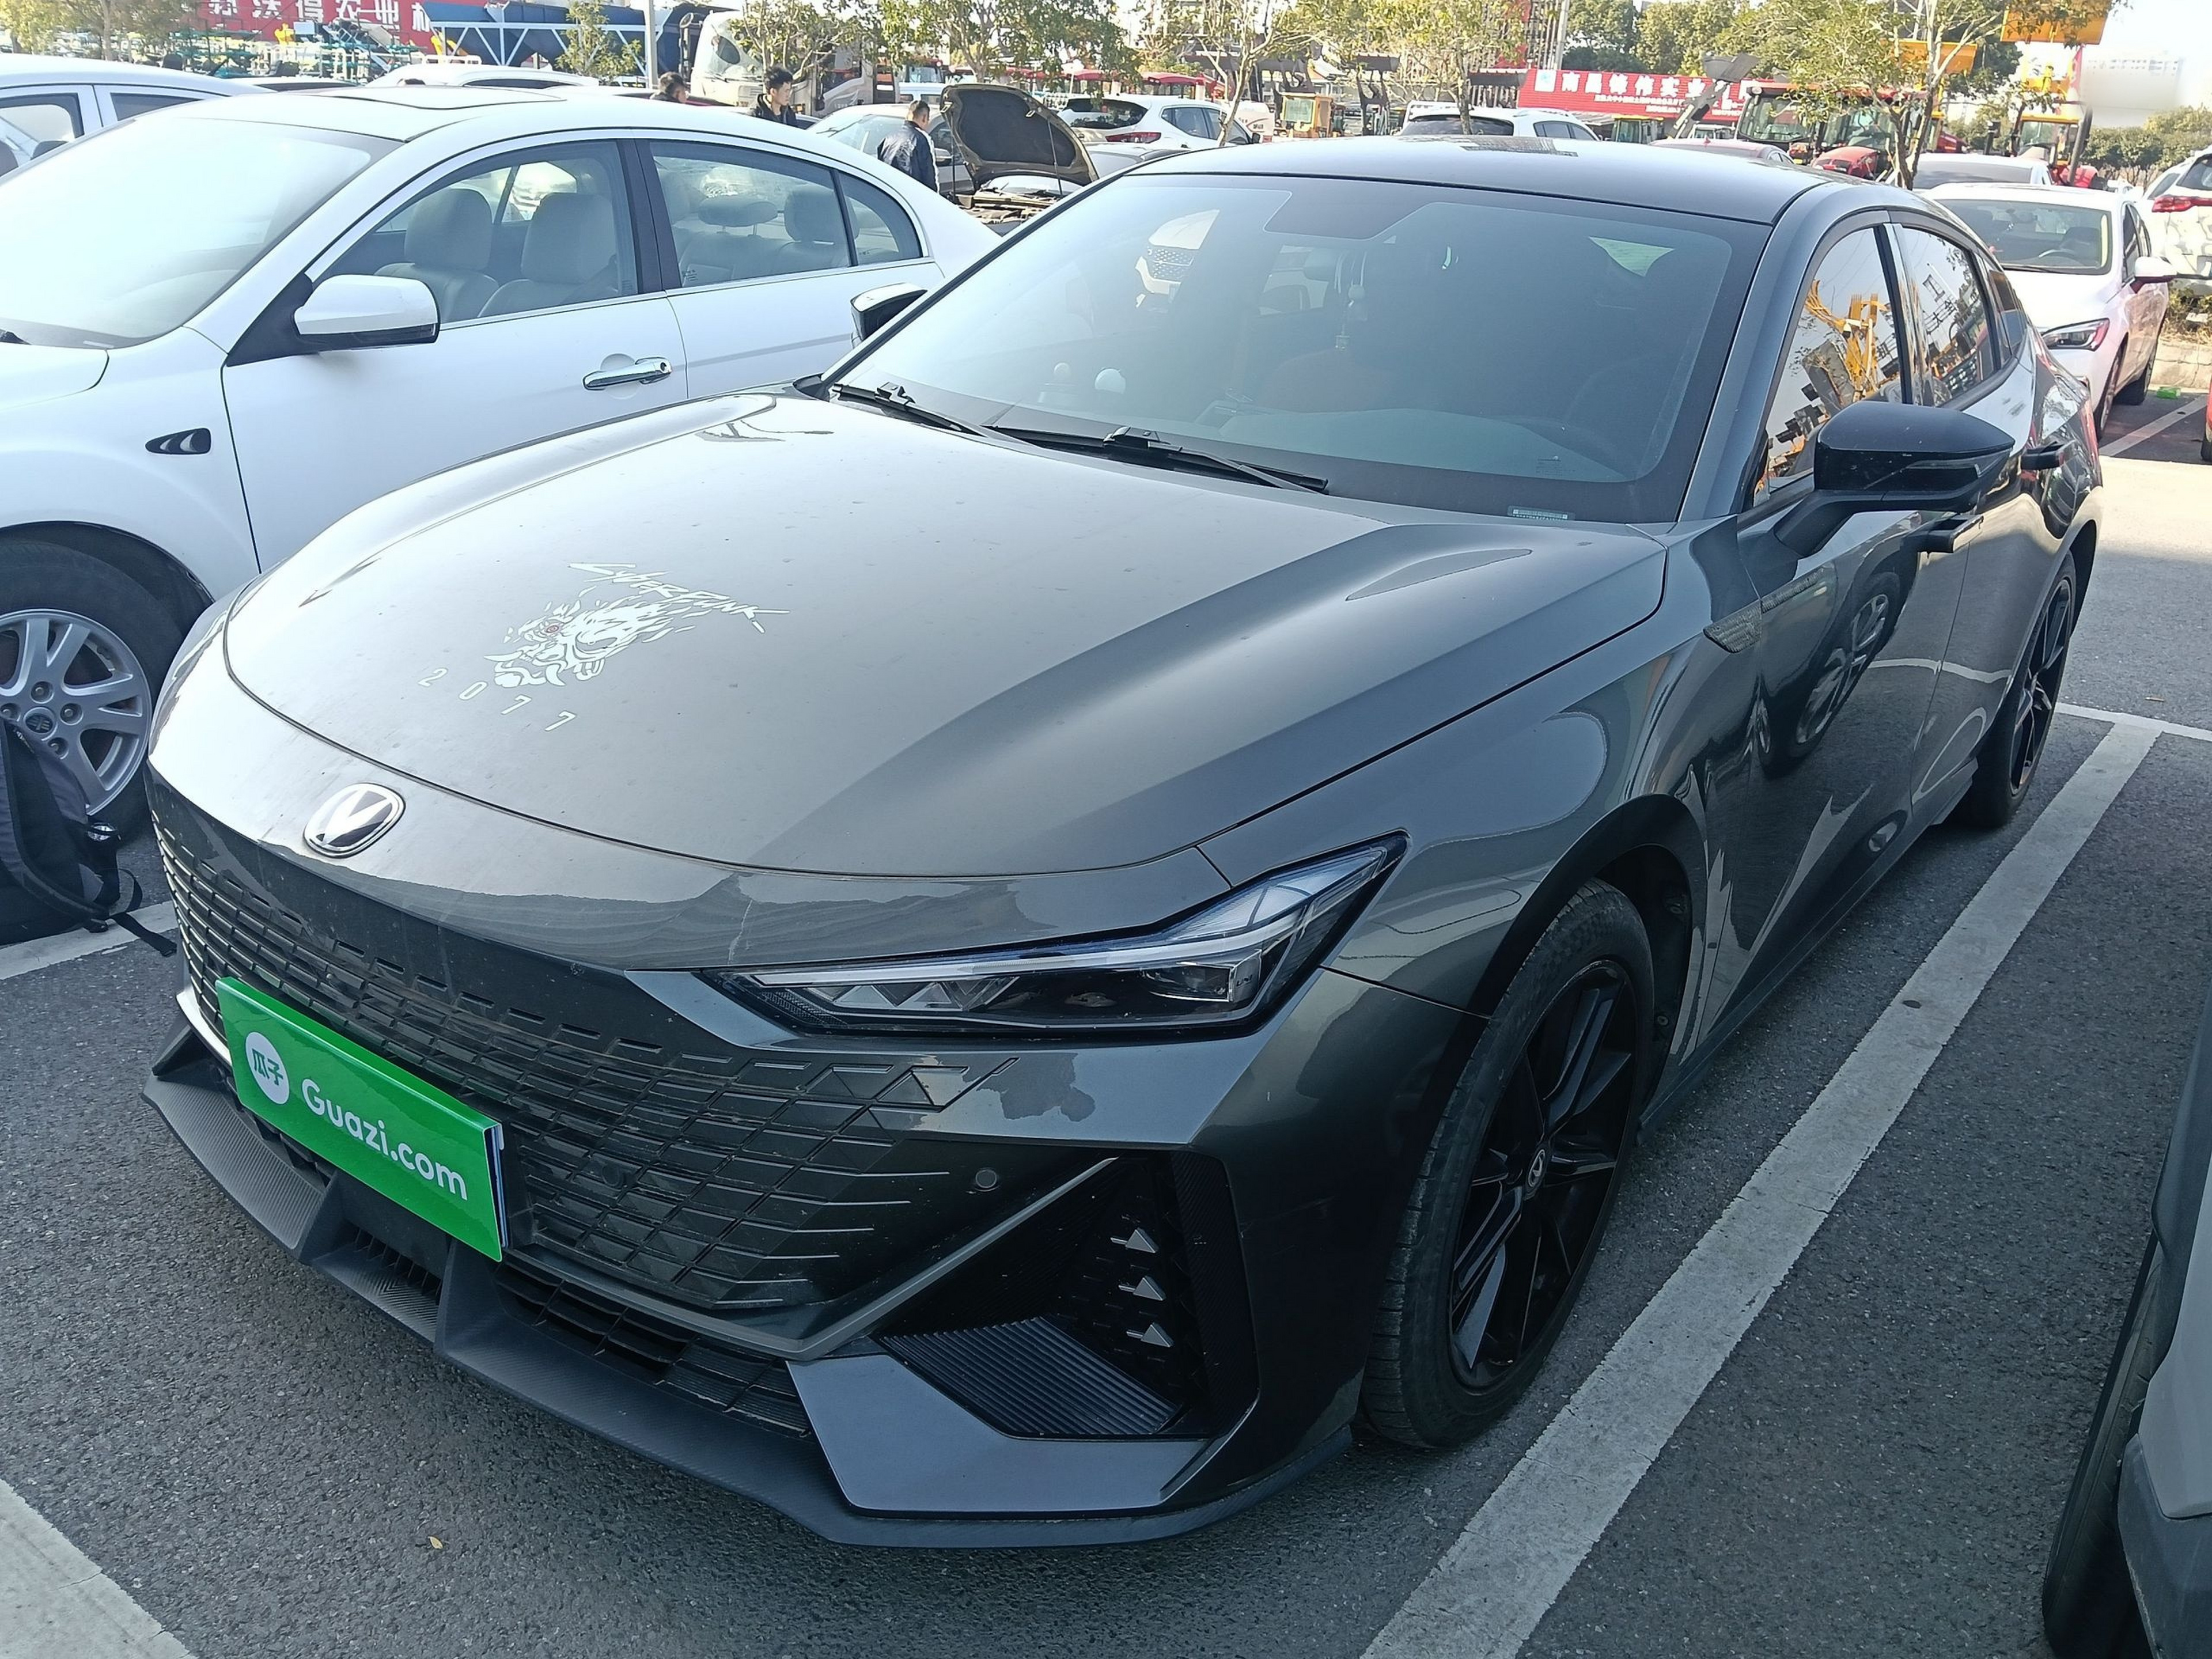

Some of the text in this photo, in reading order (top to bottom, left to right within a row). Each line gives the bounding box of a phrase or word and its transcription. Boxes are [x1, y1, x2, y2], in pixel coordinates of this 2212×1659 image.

[418, 668, 576, 732] 2077
[252, 1049, 284, 1086] 瓜子
[301, 1078, 468, 1201] Guazi.com
